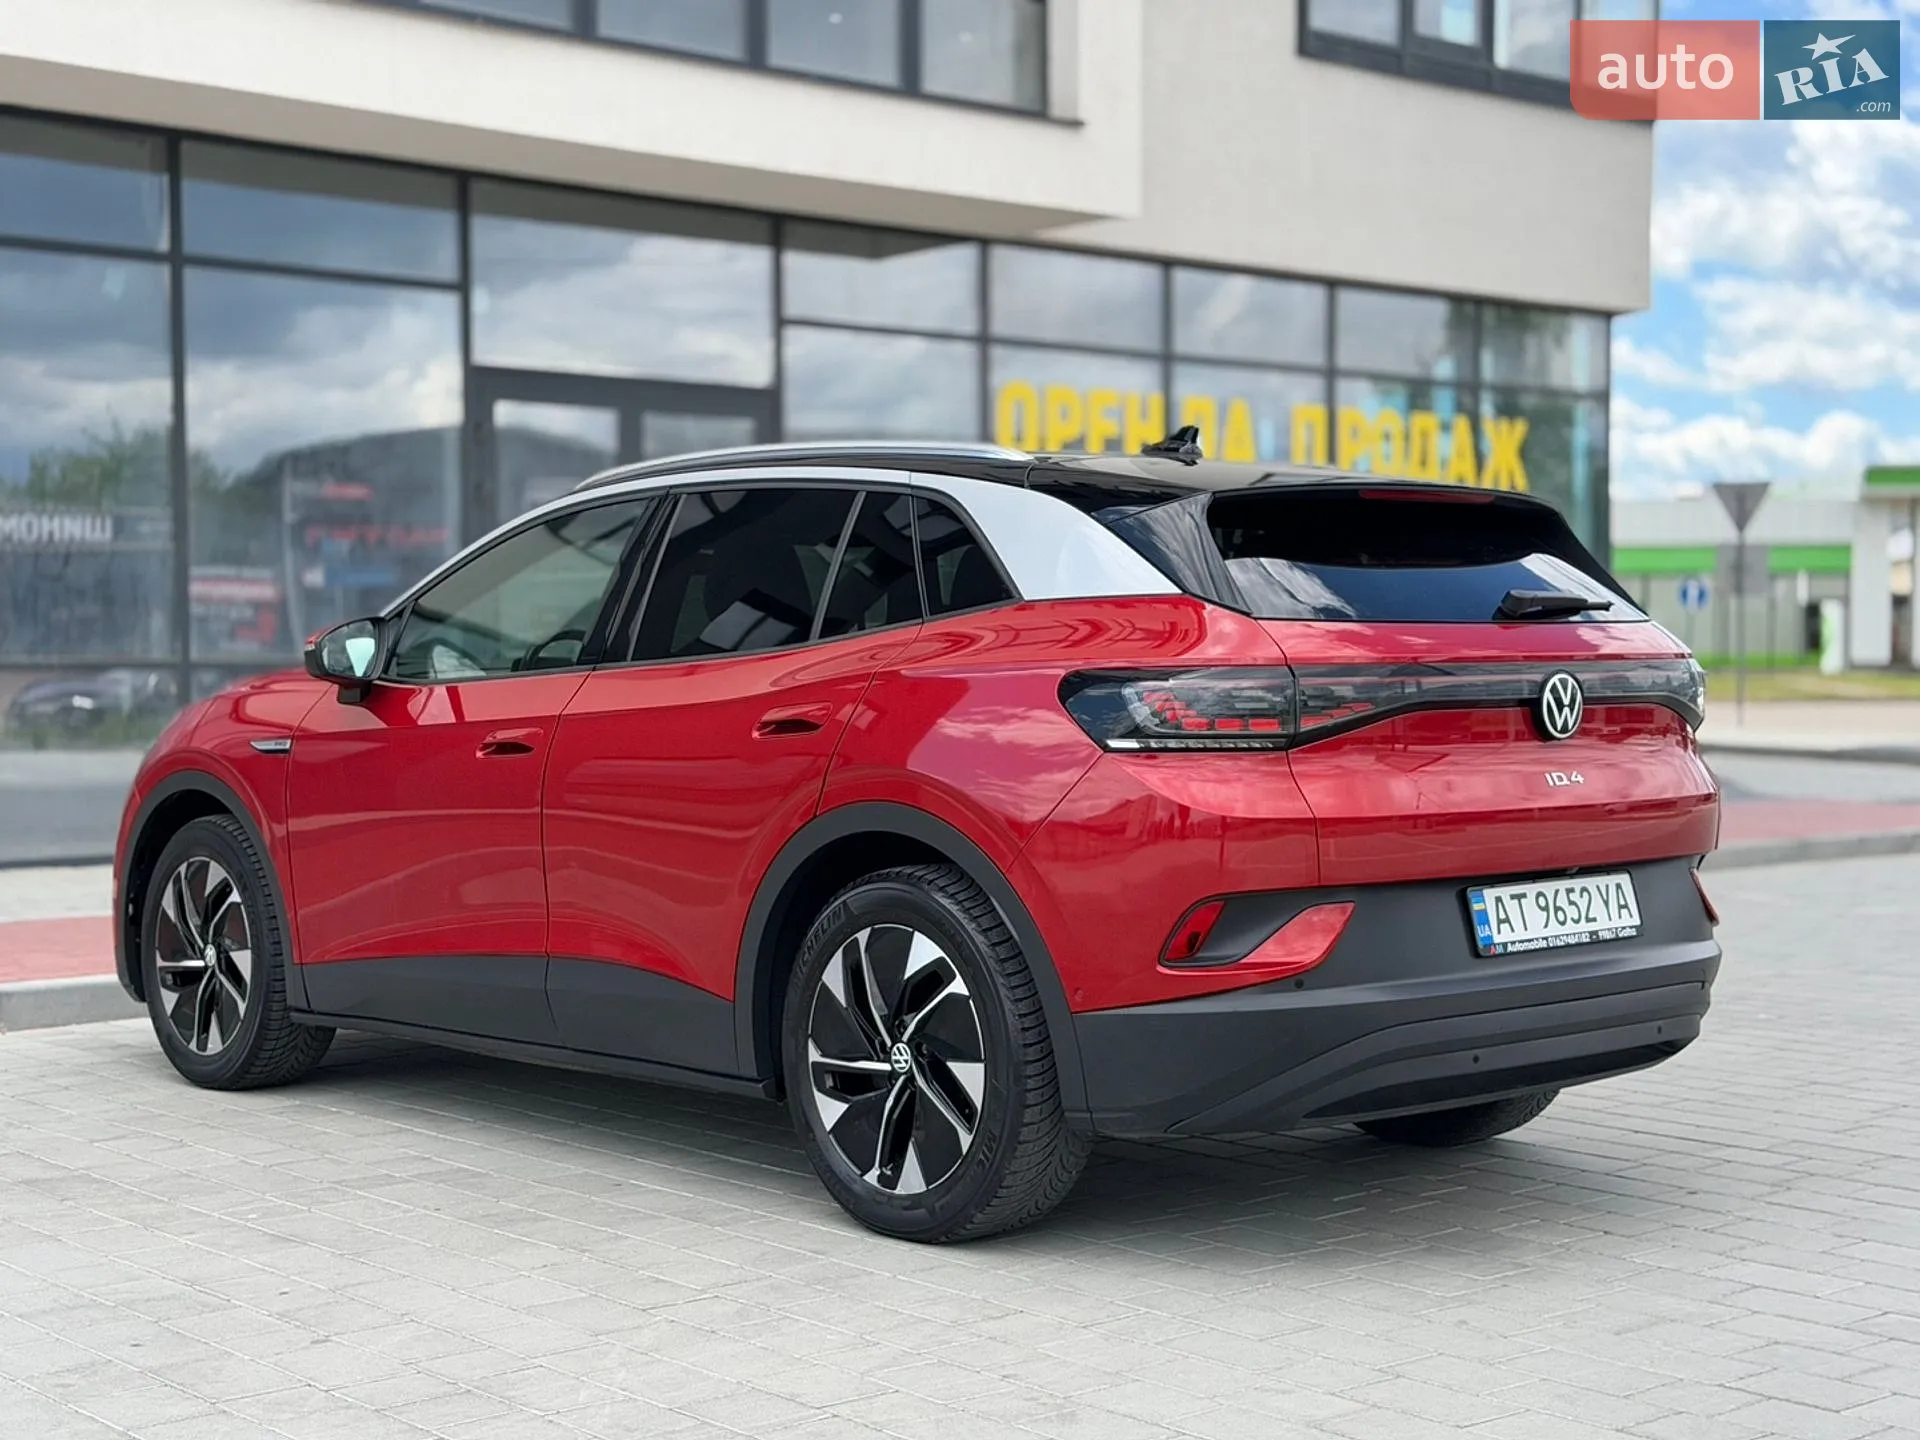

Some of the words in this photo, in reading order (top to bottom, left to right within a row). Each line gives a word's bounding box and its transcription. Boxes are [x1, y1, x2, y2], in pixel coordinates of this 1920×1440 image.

[1291, 404, 1530, 491] ПРОДАЖ
[1494, 892, 1528, 935] AT
[1535, 885, 1597, 929] 9652
[1596, 882, 1634, 922] YA
[1477, 925, 1492, 937] UA
[1506, 938, 1548, 953] Automobile
